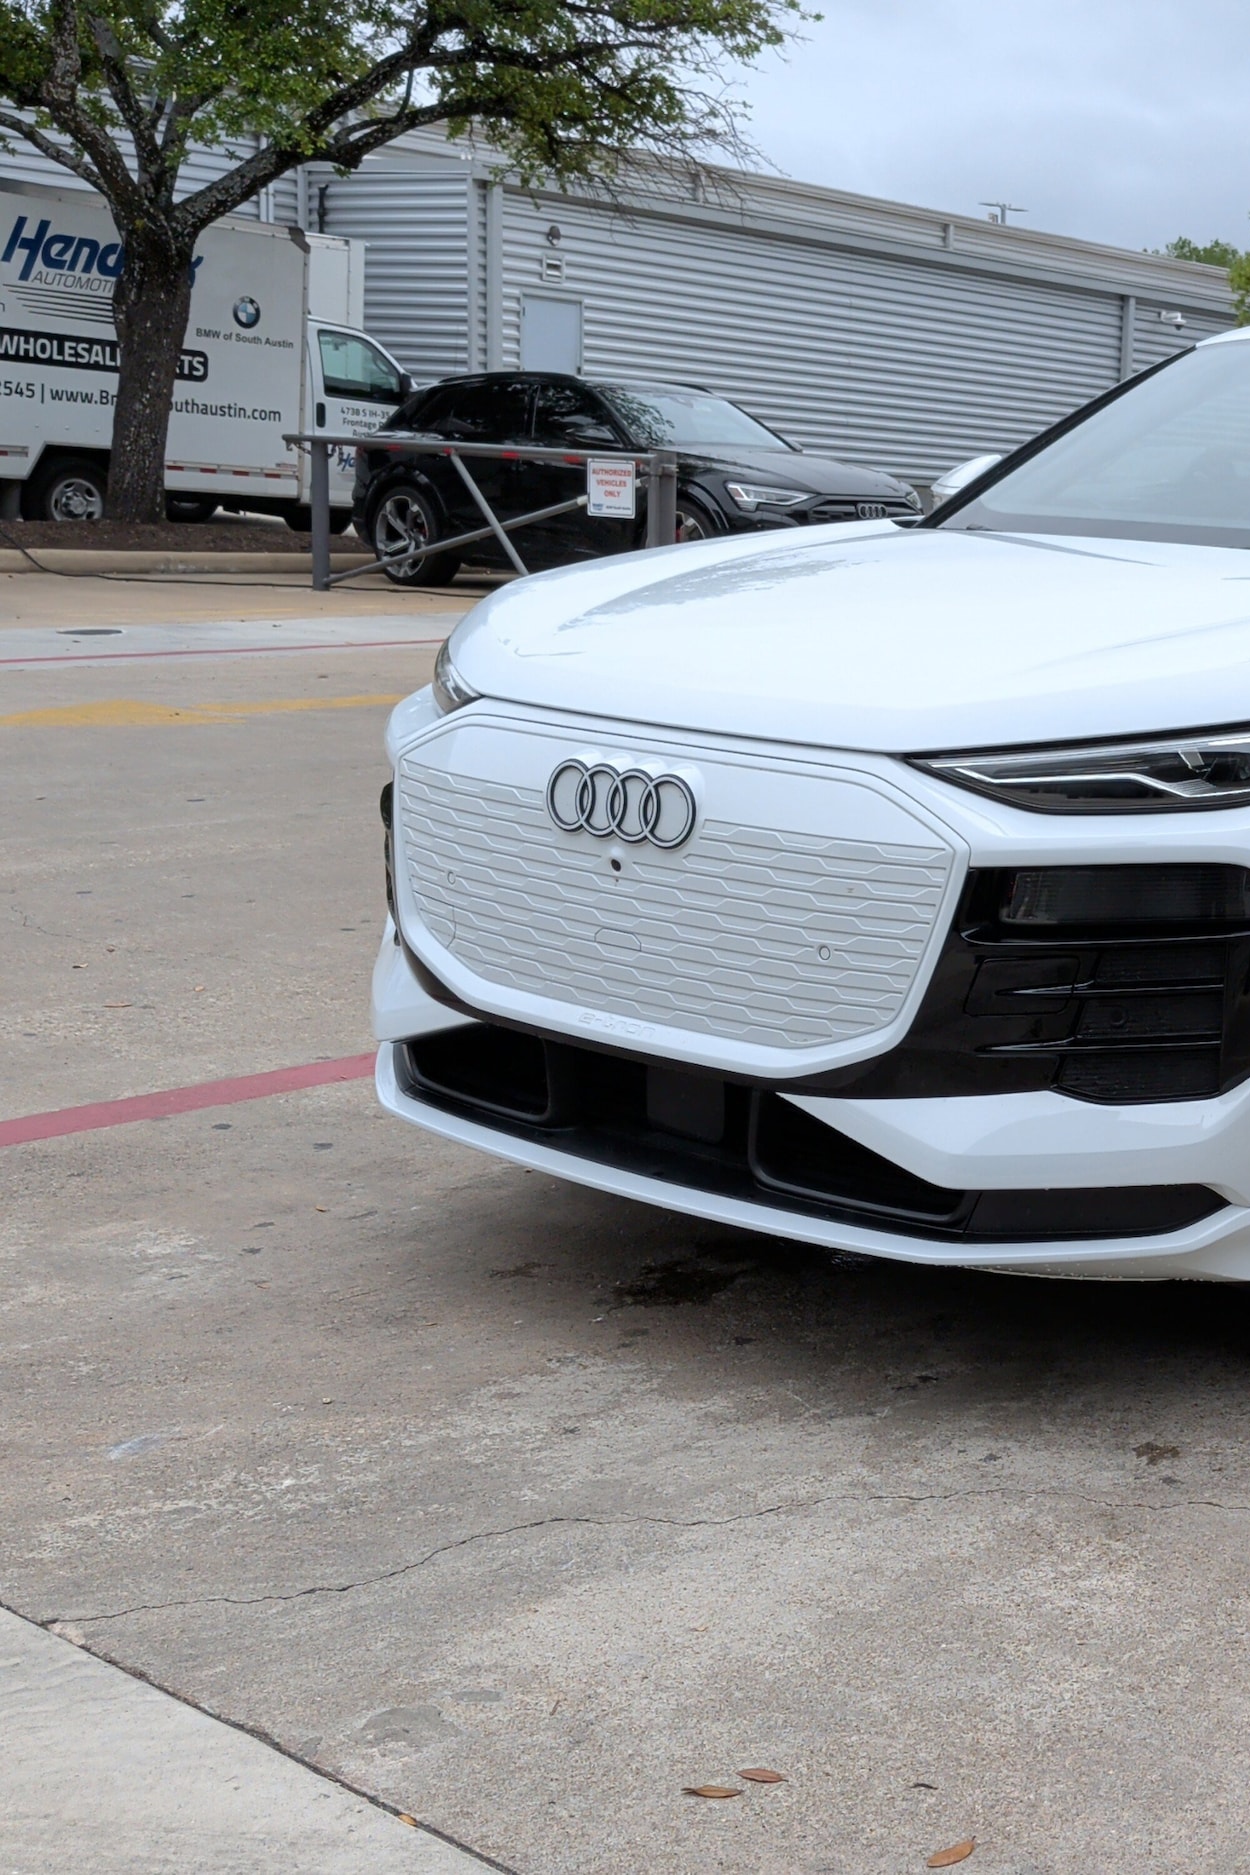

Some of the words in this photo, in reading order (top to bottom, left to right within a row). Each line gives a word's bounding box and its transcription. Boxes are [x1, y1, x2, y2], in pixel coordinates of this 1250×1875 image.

[31, 270, 114, 293] AUTOMOTI
[196, 328, 221, 339] BMW
[223, 332, 233, 341] of
[235, 334, 262, 345] South
[264, 338, 294, 349] Austin
[0, 381, 35, 399] 545
[342, 418, 377, 430] Frontage
[592, 468, 632, 477] AUTHORIZED
[579, 1012, 656, 1037] e-tron
